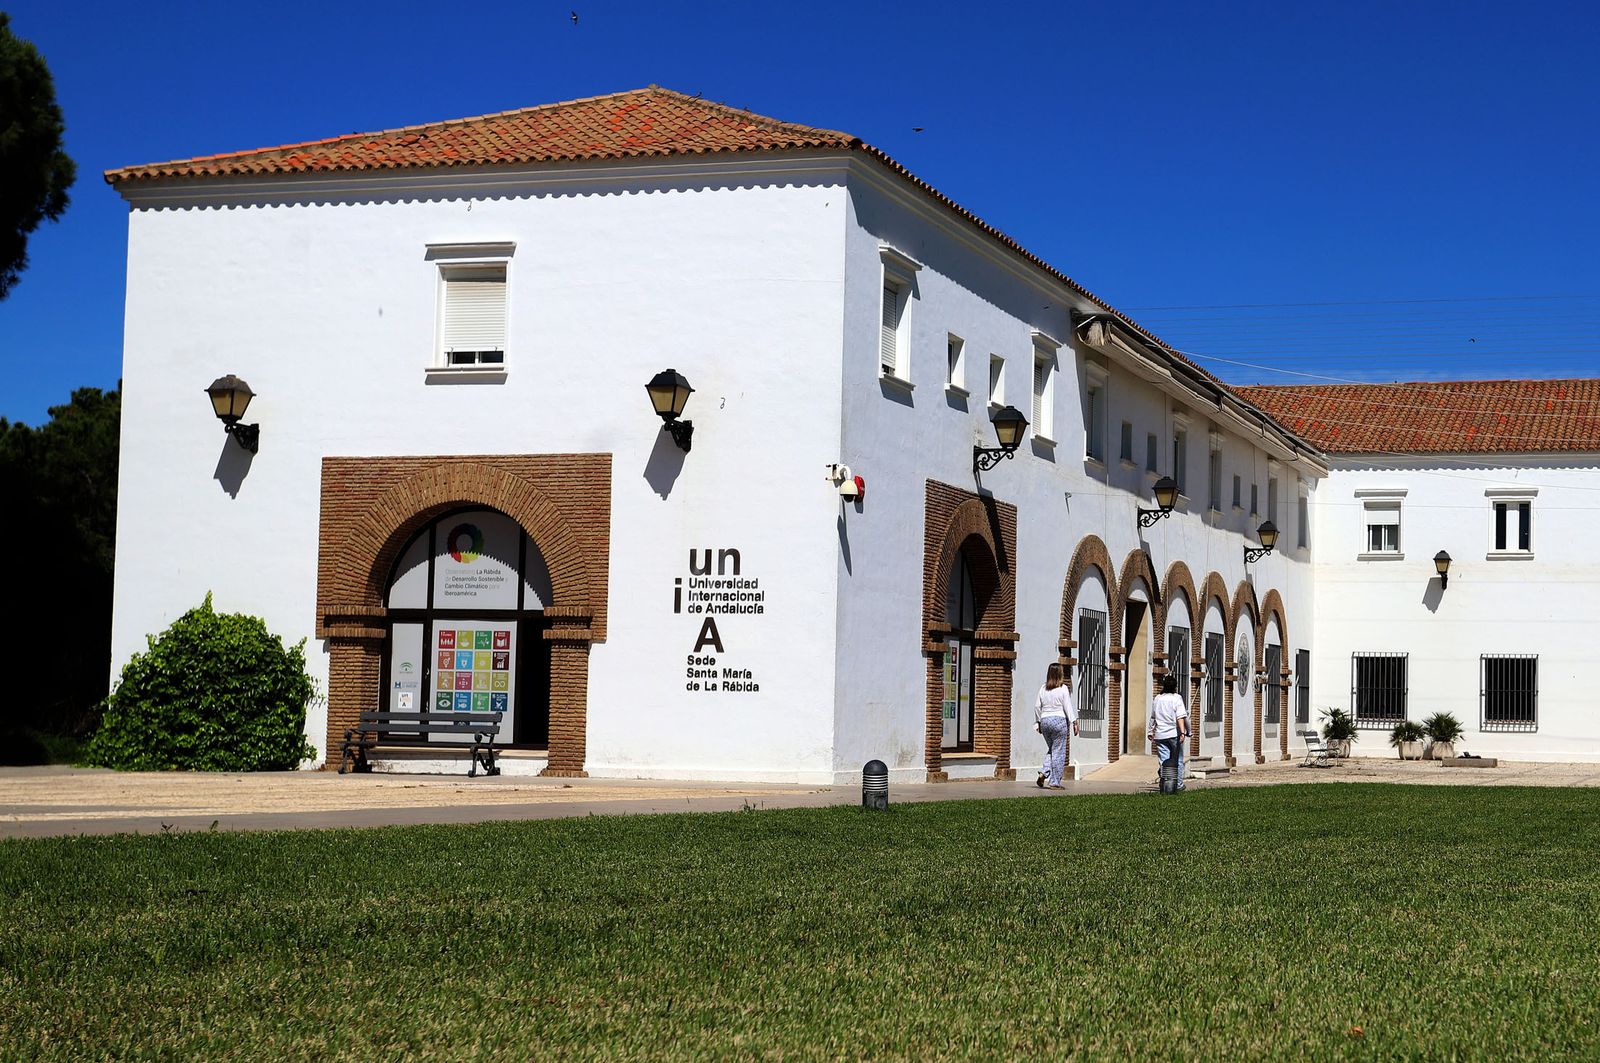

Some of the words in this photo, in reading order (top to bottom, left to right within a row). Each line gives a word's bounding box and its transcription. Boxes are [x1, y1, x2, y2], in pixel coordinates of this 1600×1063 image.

[689, 548, 741, 576] un
[688, 577, 759, 589] Universidad
[688, 590, 765, 602] Internacional
[687, 602, 703, 614] de
[705, 602, 764, 614] Andalucía
[693, 616, 725, 653] A
[686, 654, 716, 666] Sede
[686, 667, 718, 679] Santa
[722, 667, 752, 679] María
[686, 680, 700, 691] de
[704, 681, 718, 692] La
[722, 681, 760, 692] Rábida
